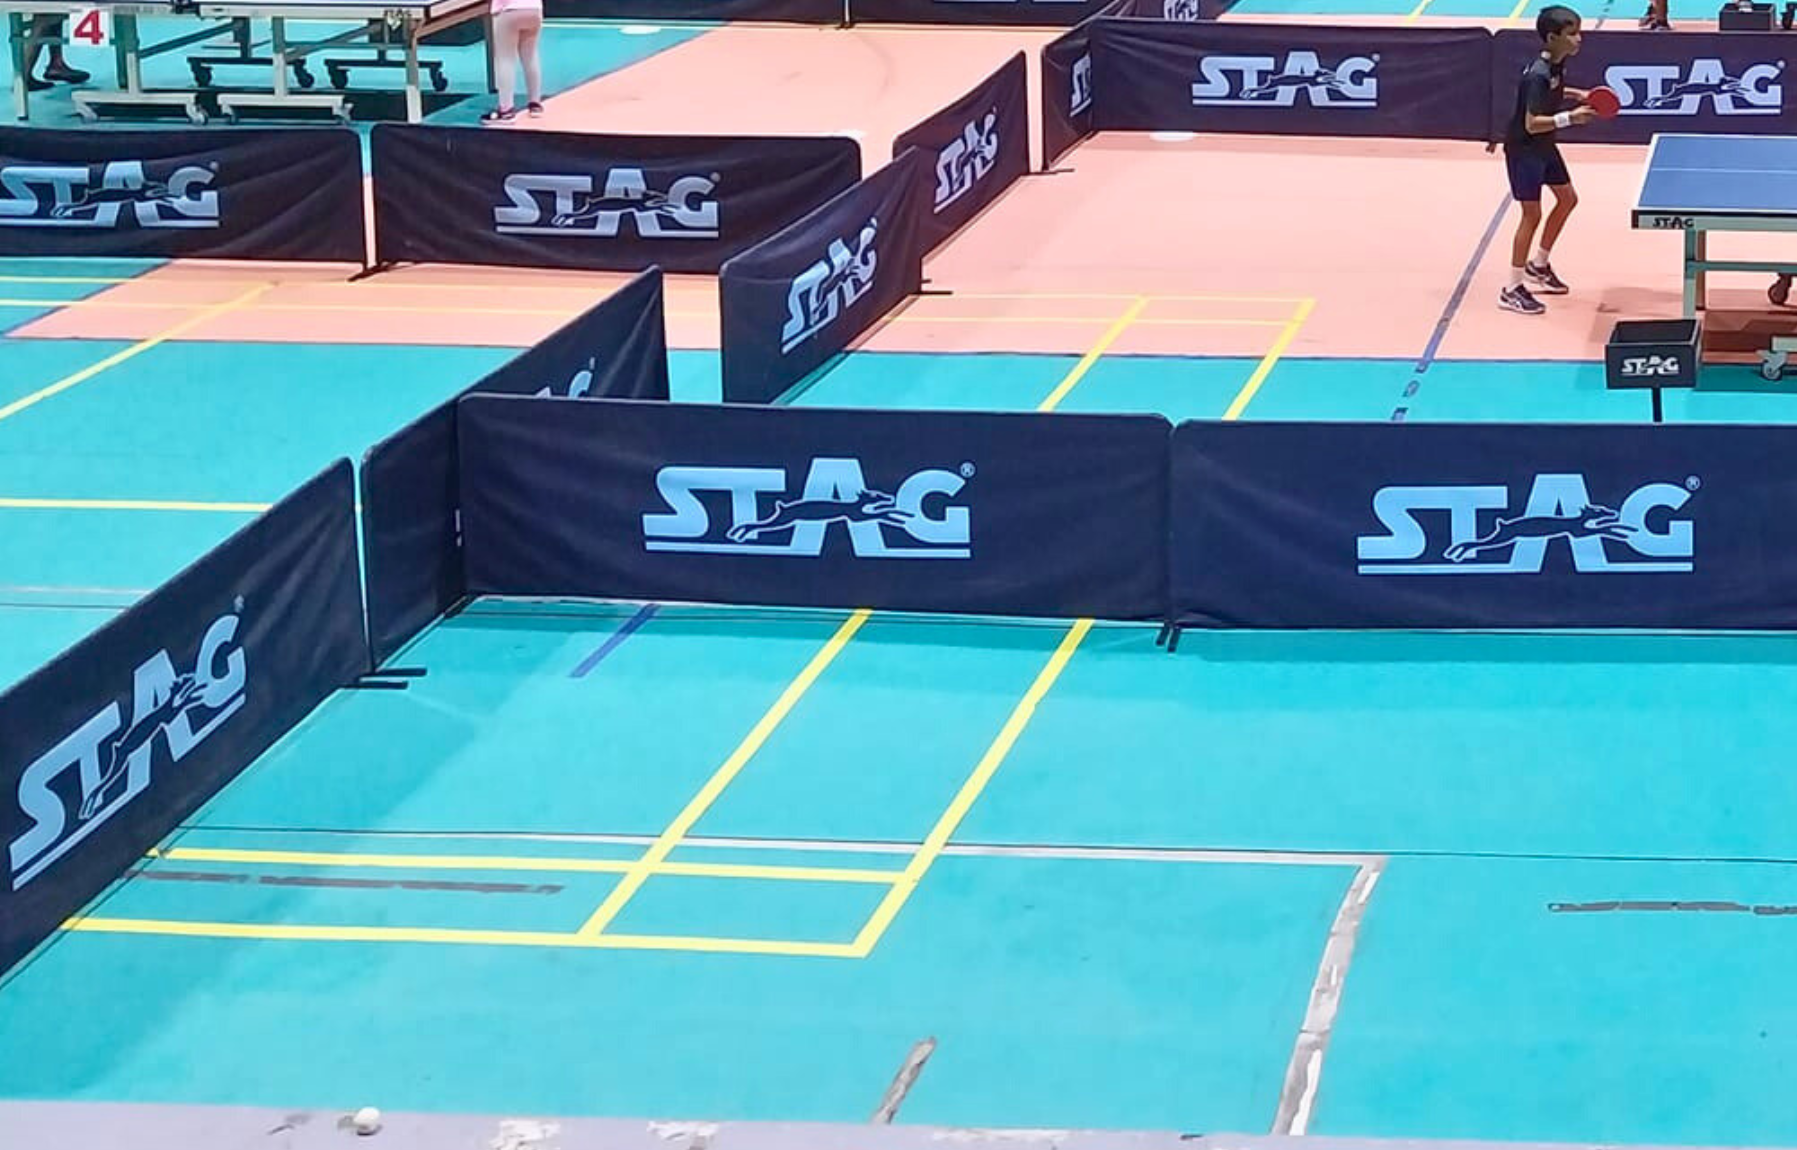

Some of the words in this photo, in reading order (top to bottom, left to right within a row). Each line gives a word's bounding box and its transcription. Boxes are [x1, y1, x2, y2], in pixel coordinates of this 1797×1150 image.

[73, 10, 104, 44] 4
[1193, 52, 1378, 107] STAG
[1605, 59, 1782, 116] STAG
[0, 161, 219, 228] STAG
[934, 112, 998, 214] STAG
[494, 168, 719, 237] STAG
[1652, 216, 1694, 229] STAG
[781, 221, 878, 353] STAG
[1620, 354, 1679, 377] STAG
[642, 457, 971, 558] STAG
[1357, 473, 1693, 575] STAG
[10, 612, 247, 891] STAG
